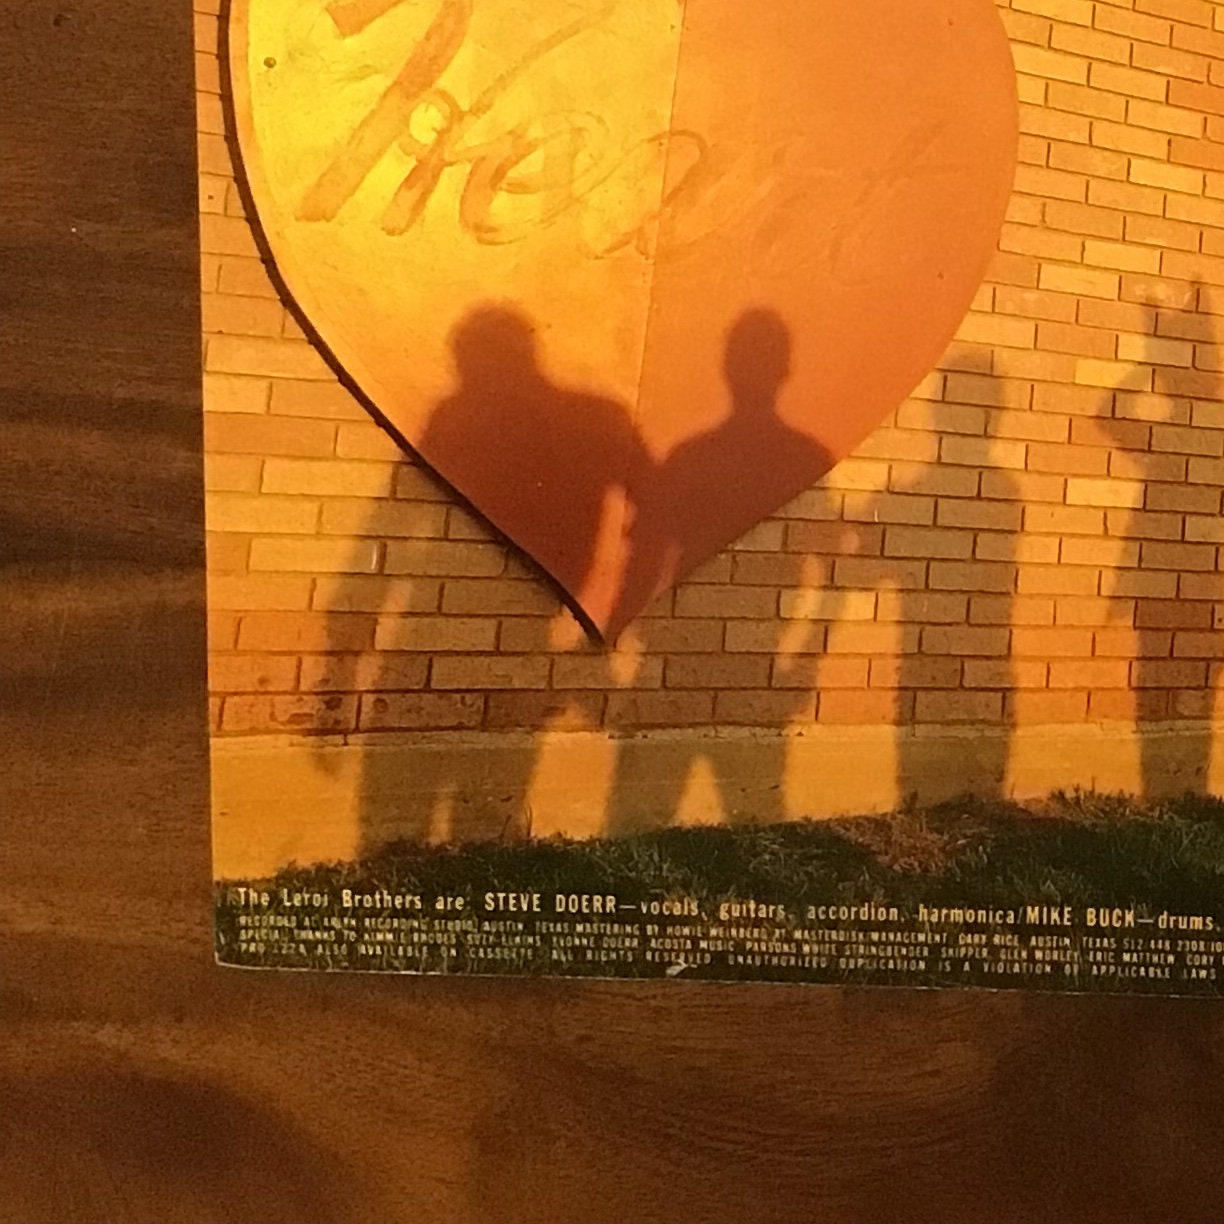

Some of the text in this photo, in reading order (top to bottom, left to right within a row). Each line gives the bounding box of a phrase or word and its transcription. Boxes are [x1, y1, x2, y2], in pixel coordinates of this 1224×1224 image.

[237, 887, 270, 906] The
[282, 888, 329, 907] Leroi
[342, 889, 422, 910] Brothers
[484, 892, 541, 912] STEVE
[963, 961, 970, 973] A
